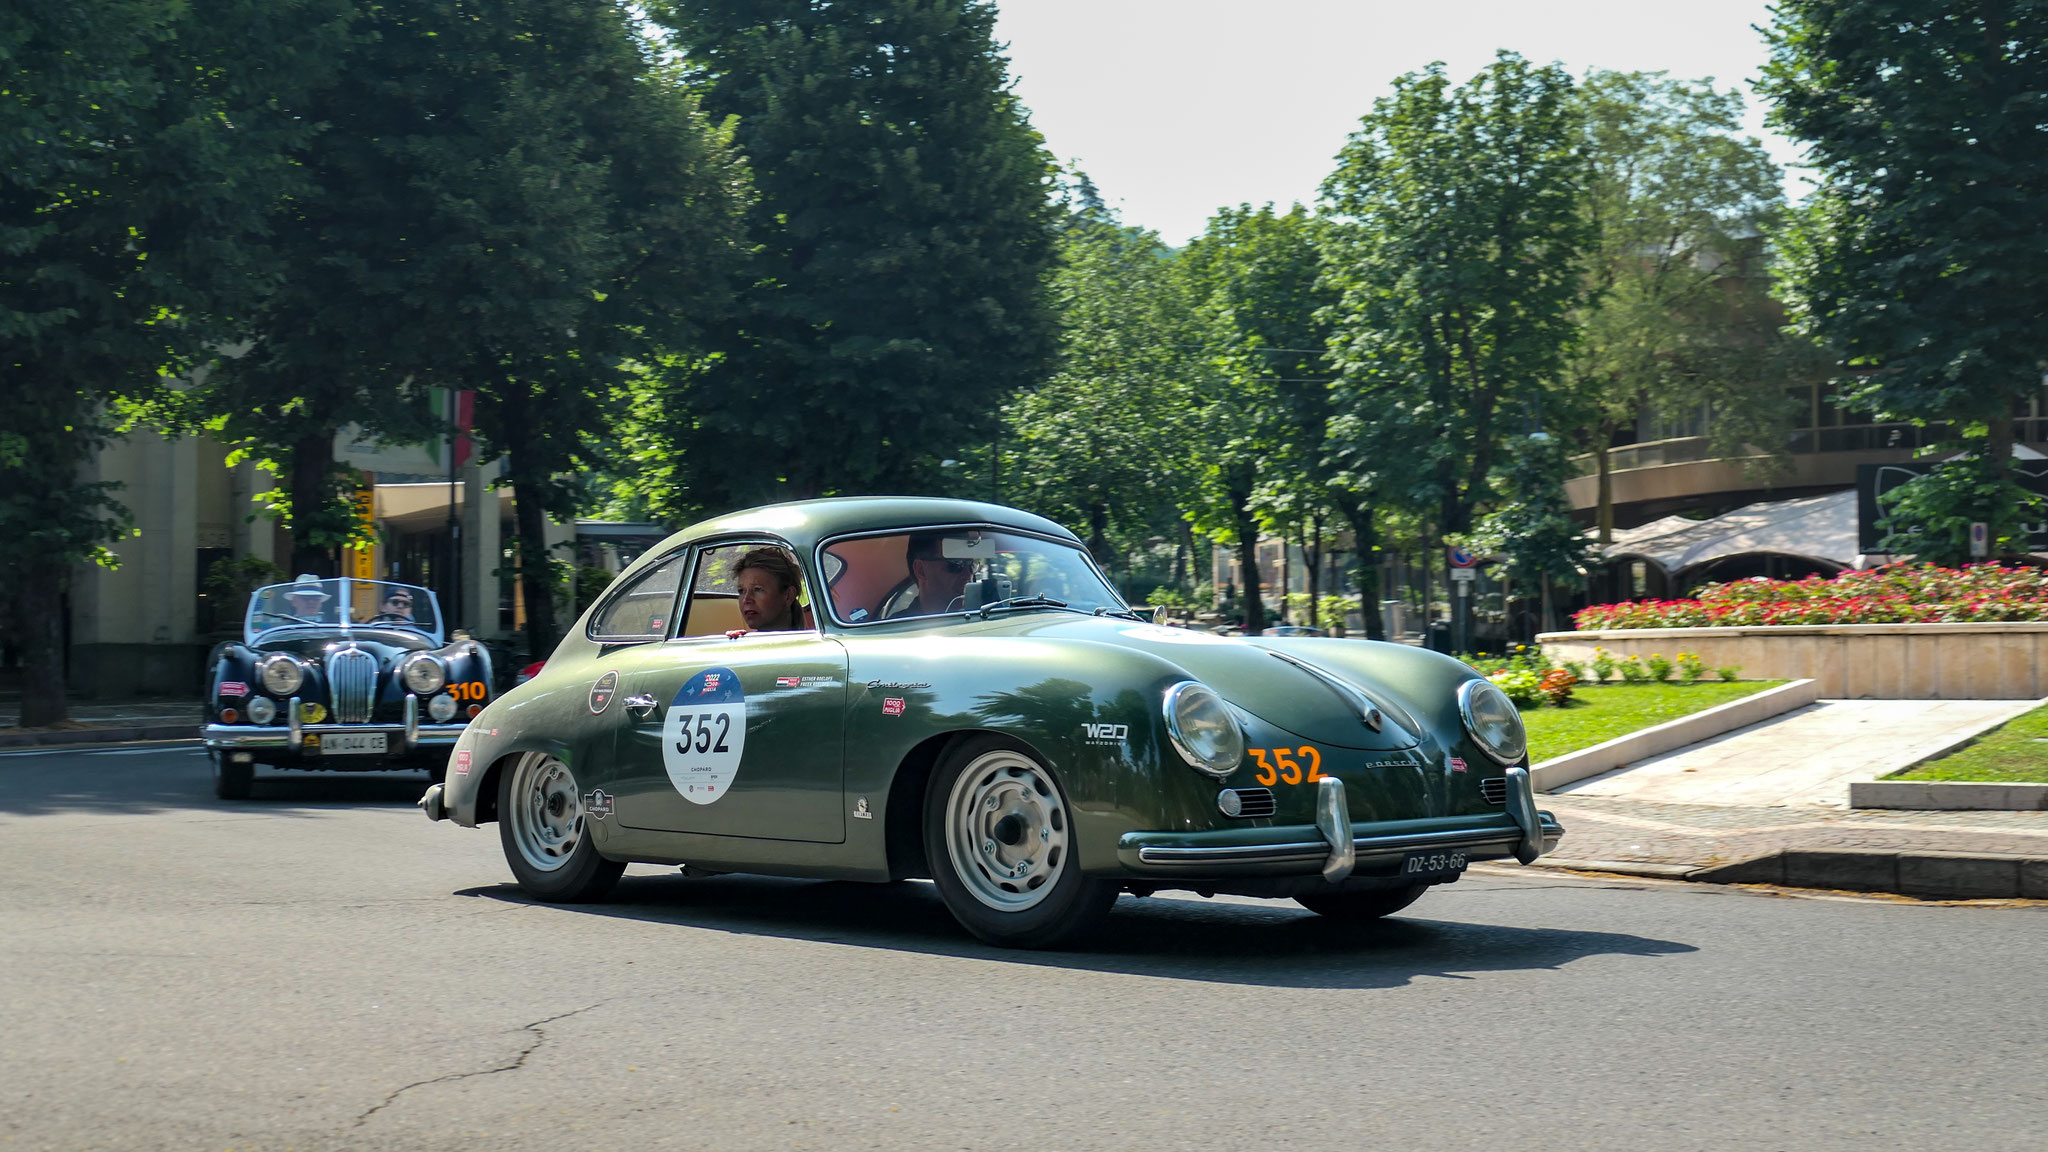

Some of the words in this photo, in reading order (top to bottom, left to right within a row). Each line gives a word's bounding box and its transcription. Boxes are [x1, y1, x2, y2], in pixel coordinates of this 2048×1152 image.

[445, 682, 486, 701] 310
[676, 713, 730, 754] 352
[1248, 745, 1329, 786] 352
[1365, 760, 1421, 769] PORSCHE
[1407, 853, 1466, 873] DZ-53-66
